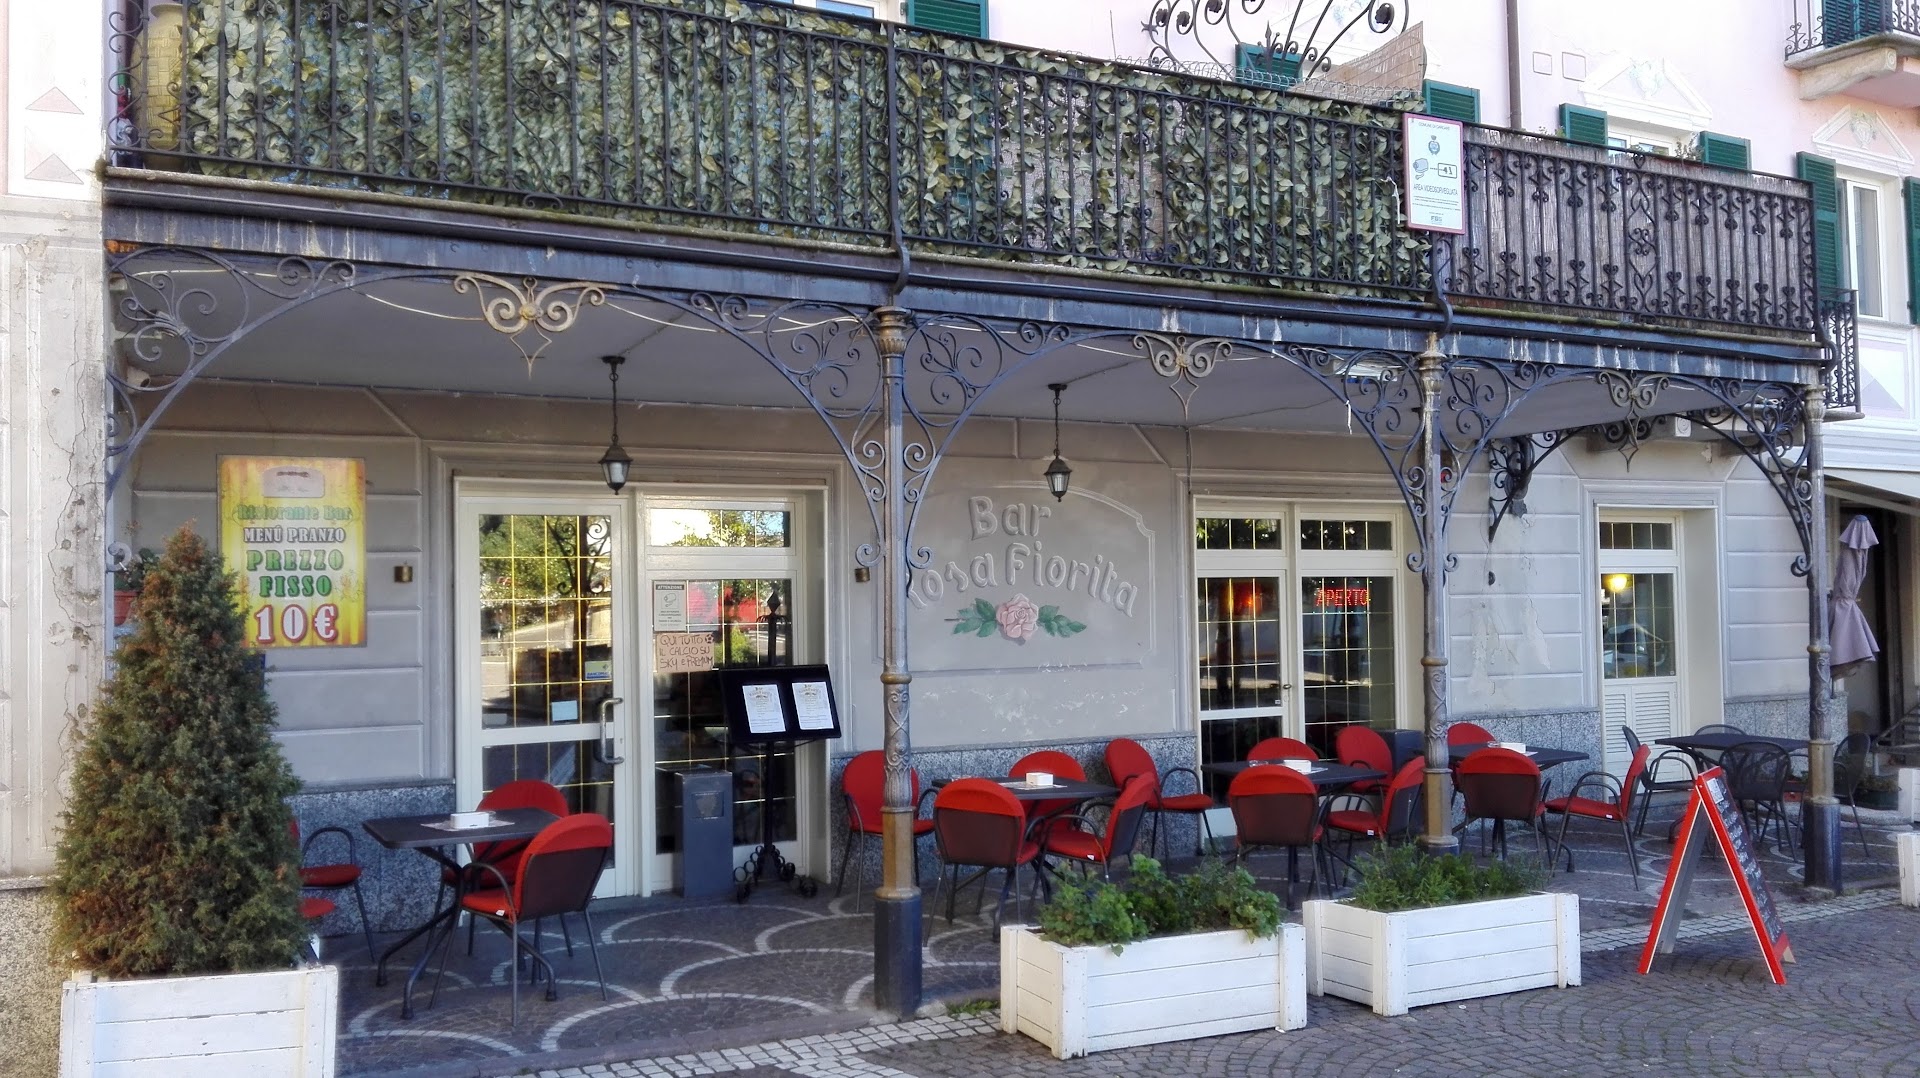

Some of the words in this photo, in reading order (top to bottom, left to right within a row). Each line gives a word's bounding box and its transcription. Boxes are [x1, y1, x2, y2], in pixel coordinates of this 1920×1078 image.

[1413, 183, 1424, 191] AREA
[237, 504, 320, 520] Ristorante
[323, 505, 352, 520] Bar
[968, 495, 1051, 541] Bar
[287, 527, 346, 544] PRANZO
[246, 549, 344, 571] PREZZO
[259, 575, 333, 597] FISSO
[1005, 541, 1138, 617] Fiorita
[1315, 589, 1369, 606] APERTO
[660, 634, 677, 647] QUI
[679, 634, 703, 645] TUTTO
[660, 647, 666, 656] IL
[669, 647, 698, 656] CALCIO
[700, 646, 710, 654] SU
